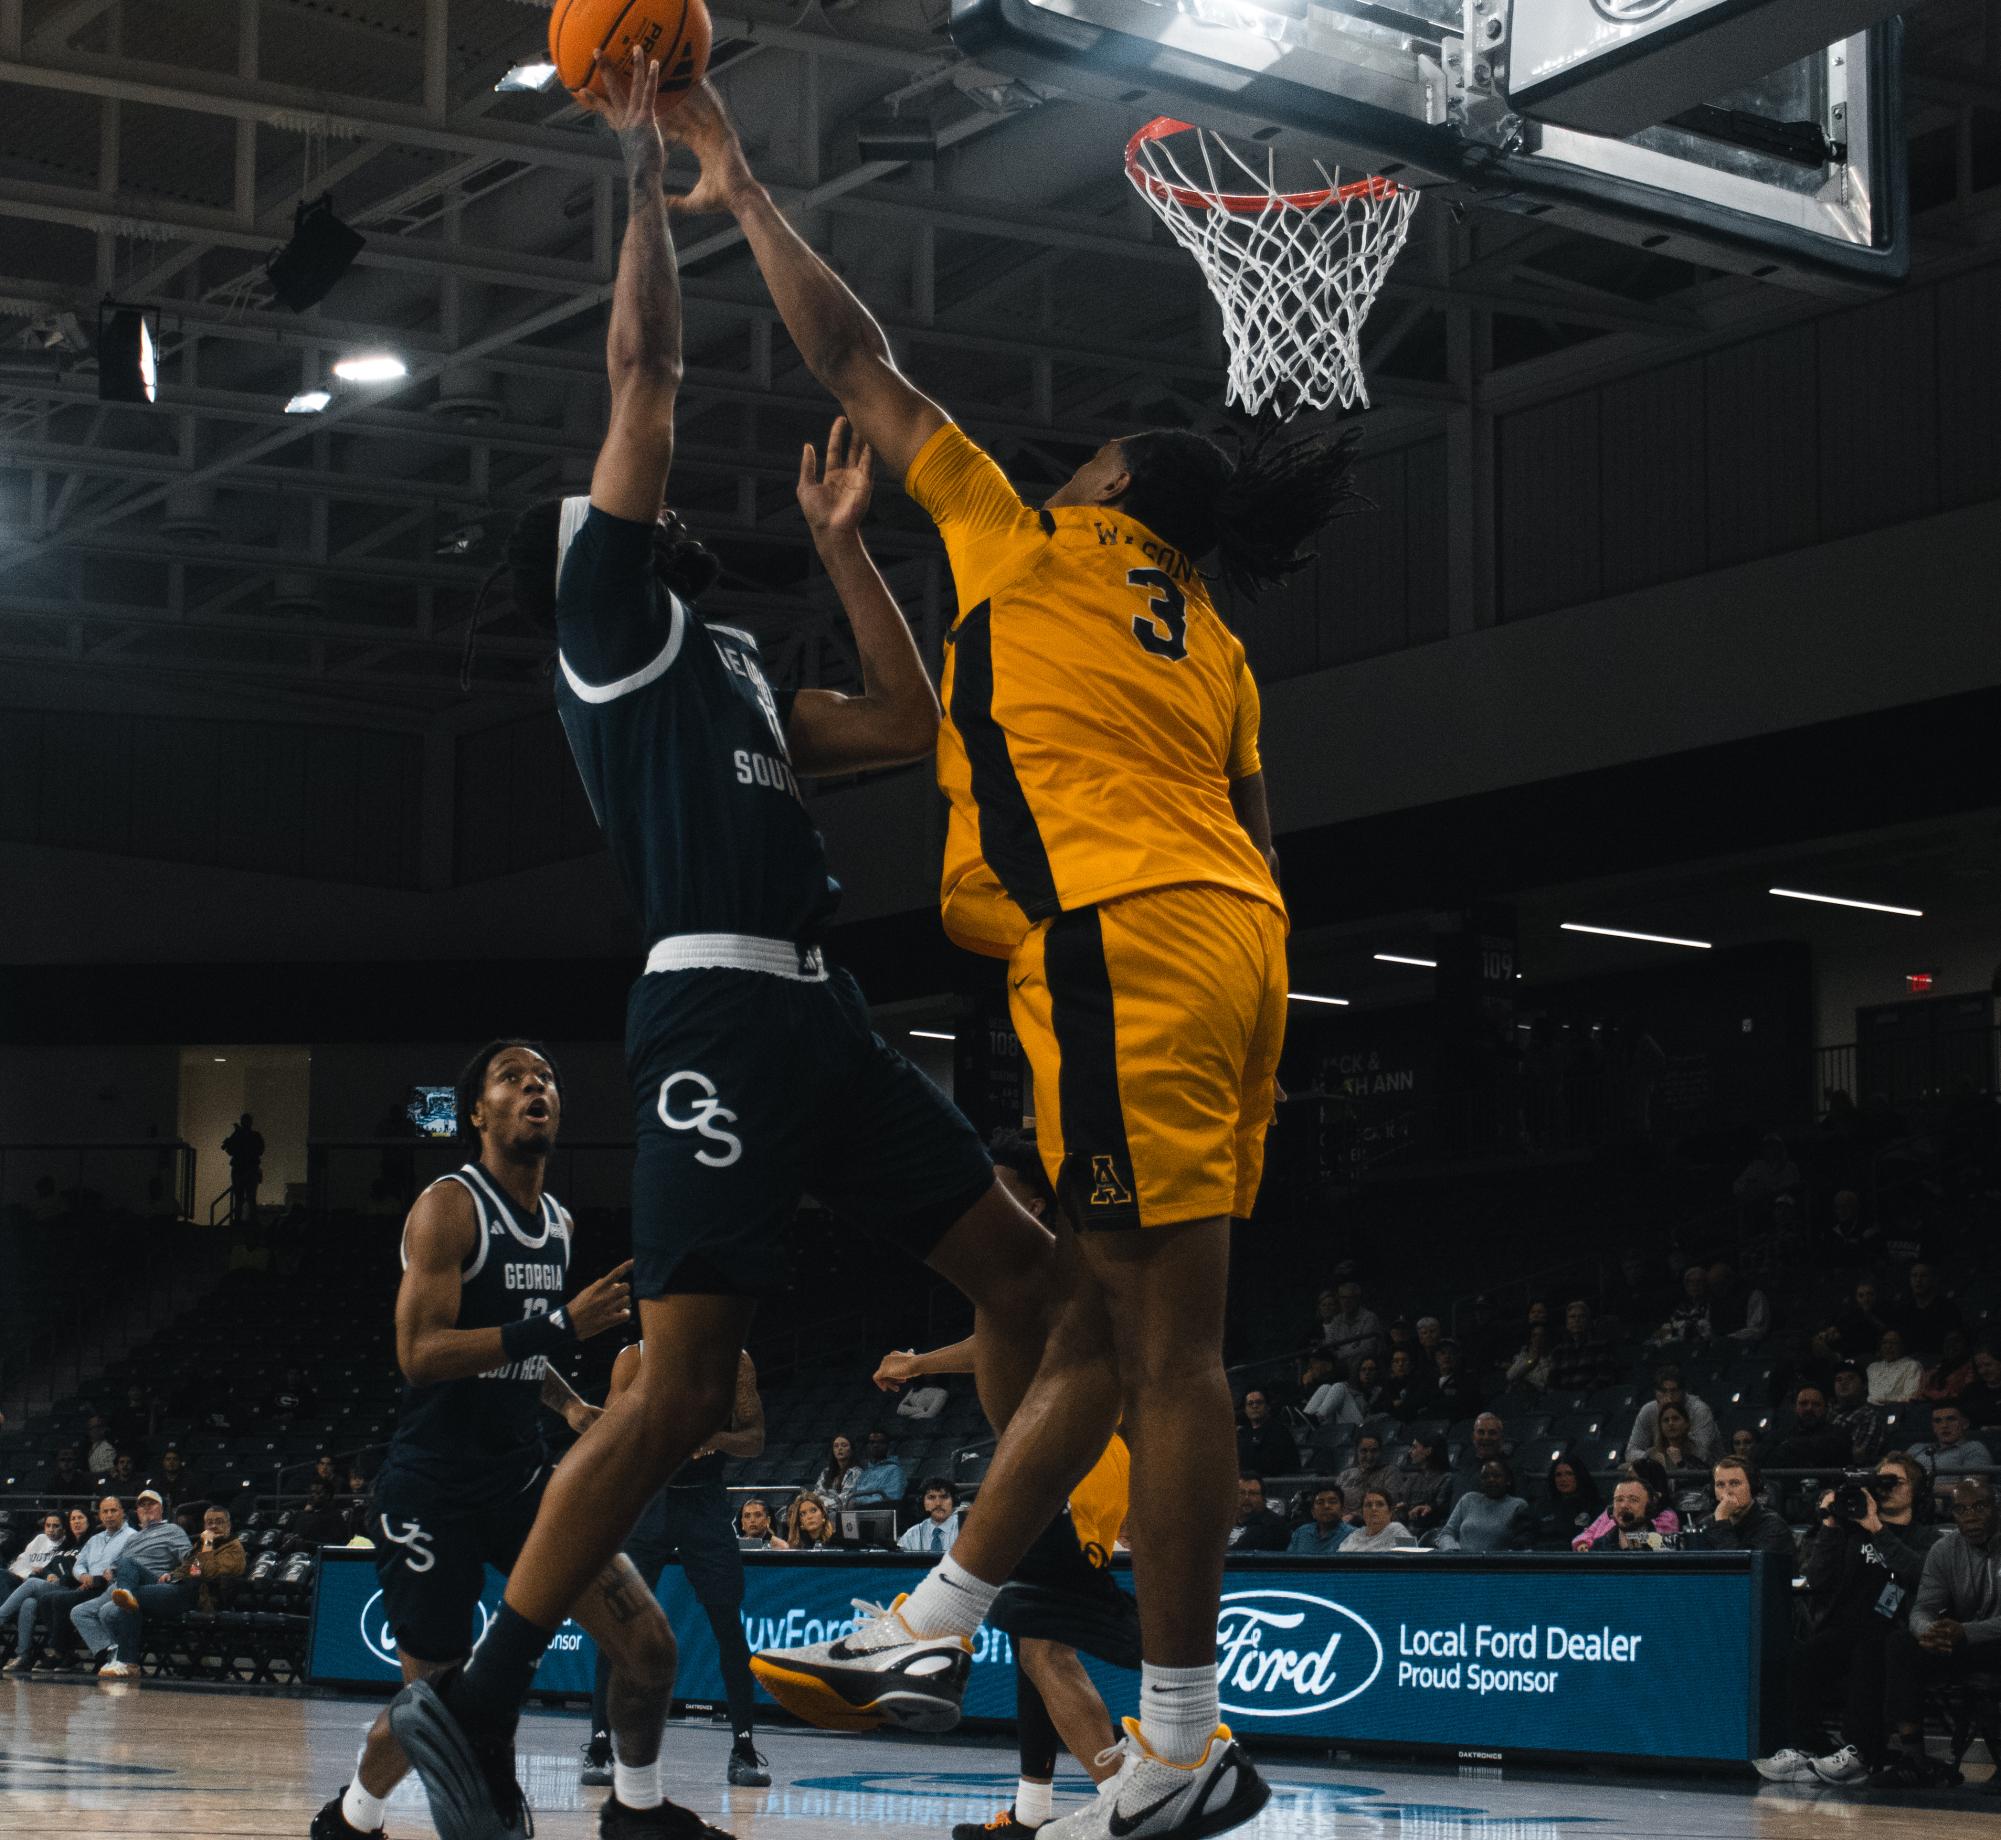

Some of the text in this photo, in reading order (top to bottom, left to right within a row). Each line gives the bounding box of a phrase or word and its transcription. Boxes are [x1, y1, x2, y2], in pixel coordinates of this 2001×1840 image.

[1094, 521, 1194, 583] WSON
[1125, 567, 1191, 663] 3
[1482, 951, 1513, 980] 109
[1372, 1070, 1415, 1094] ANN
[657, 1070, 742, 1168] GS
[1090, 1154, 1133, 1205] A
[504, 1262, 564, 1291] GEORGIA
[1216, 1606, 1342, 1696] Ford
[1399, 1622, 1643, 1663] Local Ford Dealer
[1397, 1660, 1559, 1696] Proud Sponsor
[1458, 1751, 1503, 1760] DAKTRONICS
